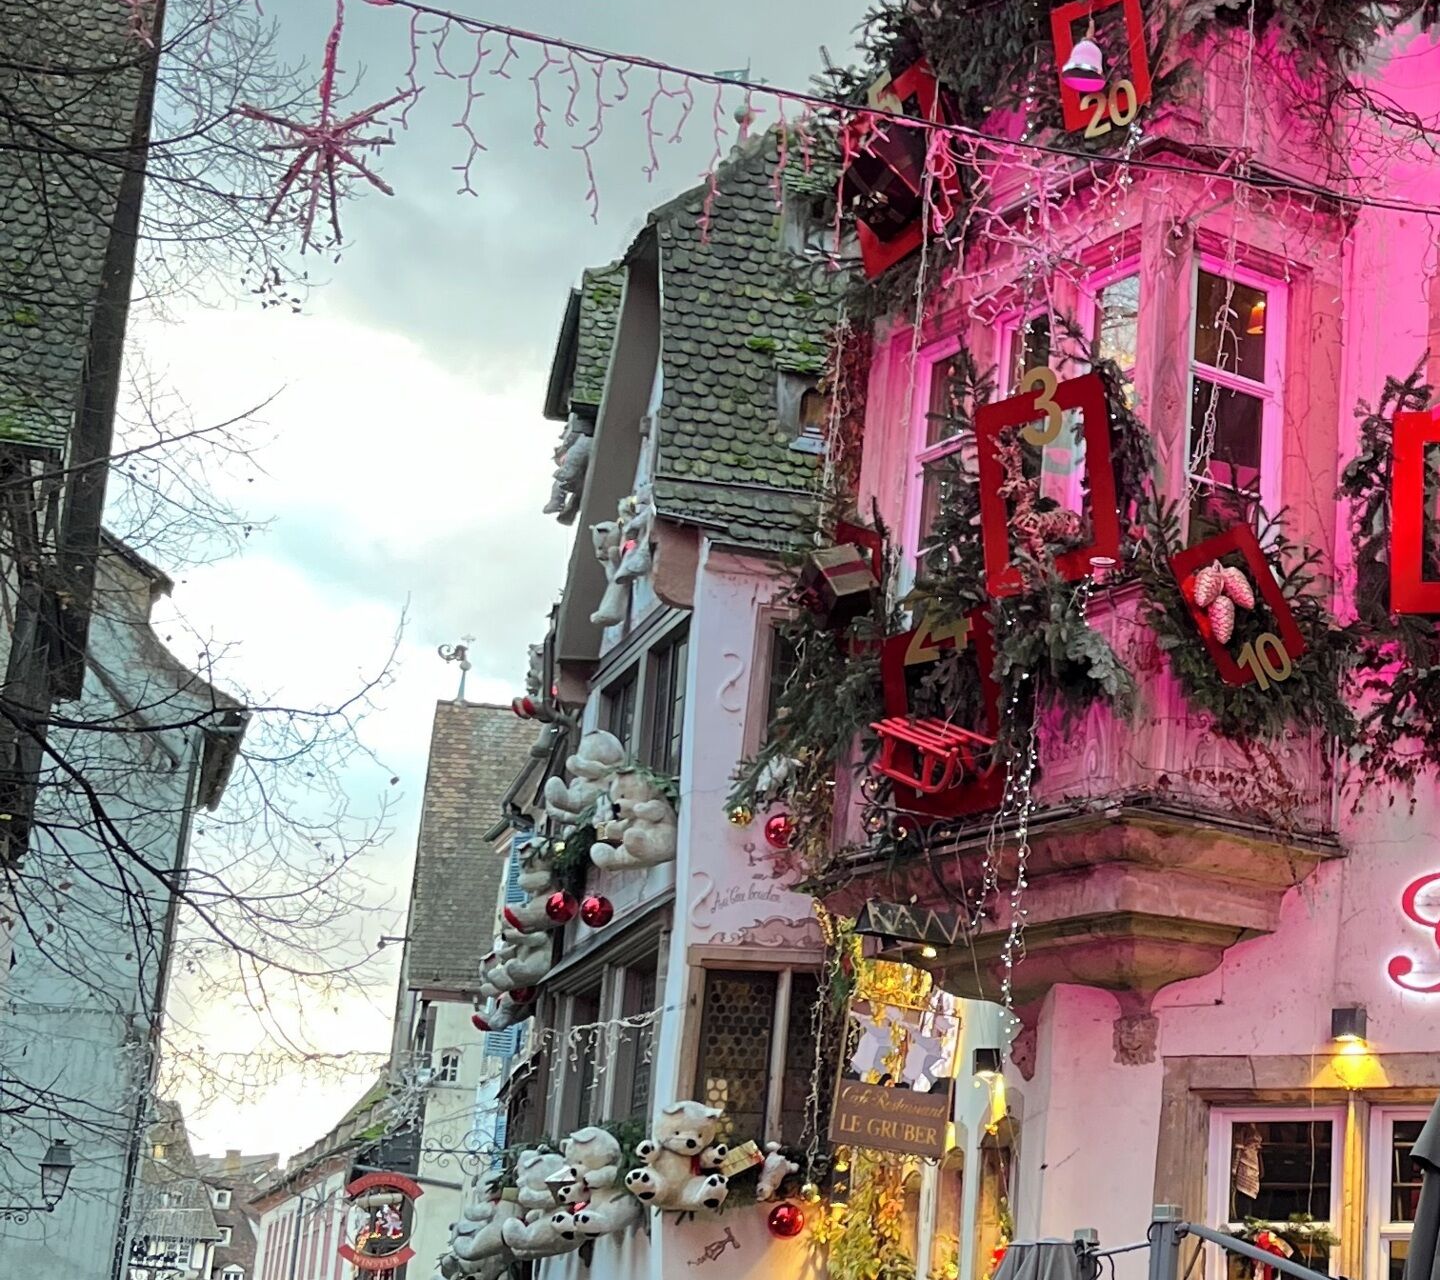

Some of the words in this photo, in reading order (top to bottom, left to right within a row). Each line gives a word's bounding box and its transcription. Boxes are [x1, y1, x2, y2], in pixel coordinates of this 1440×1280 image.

[1079, 79, 1137, 139] 20
[1019, 366, 1064, 447] 3
[1237, 631, 1293, 692] 10
[840, 1114, 862, 1133] LE
[866, 1118, 938, 1146] GRUBER
[352, 1253, 400, 1270] WINSTUB
